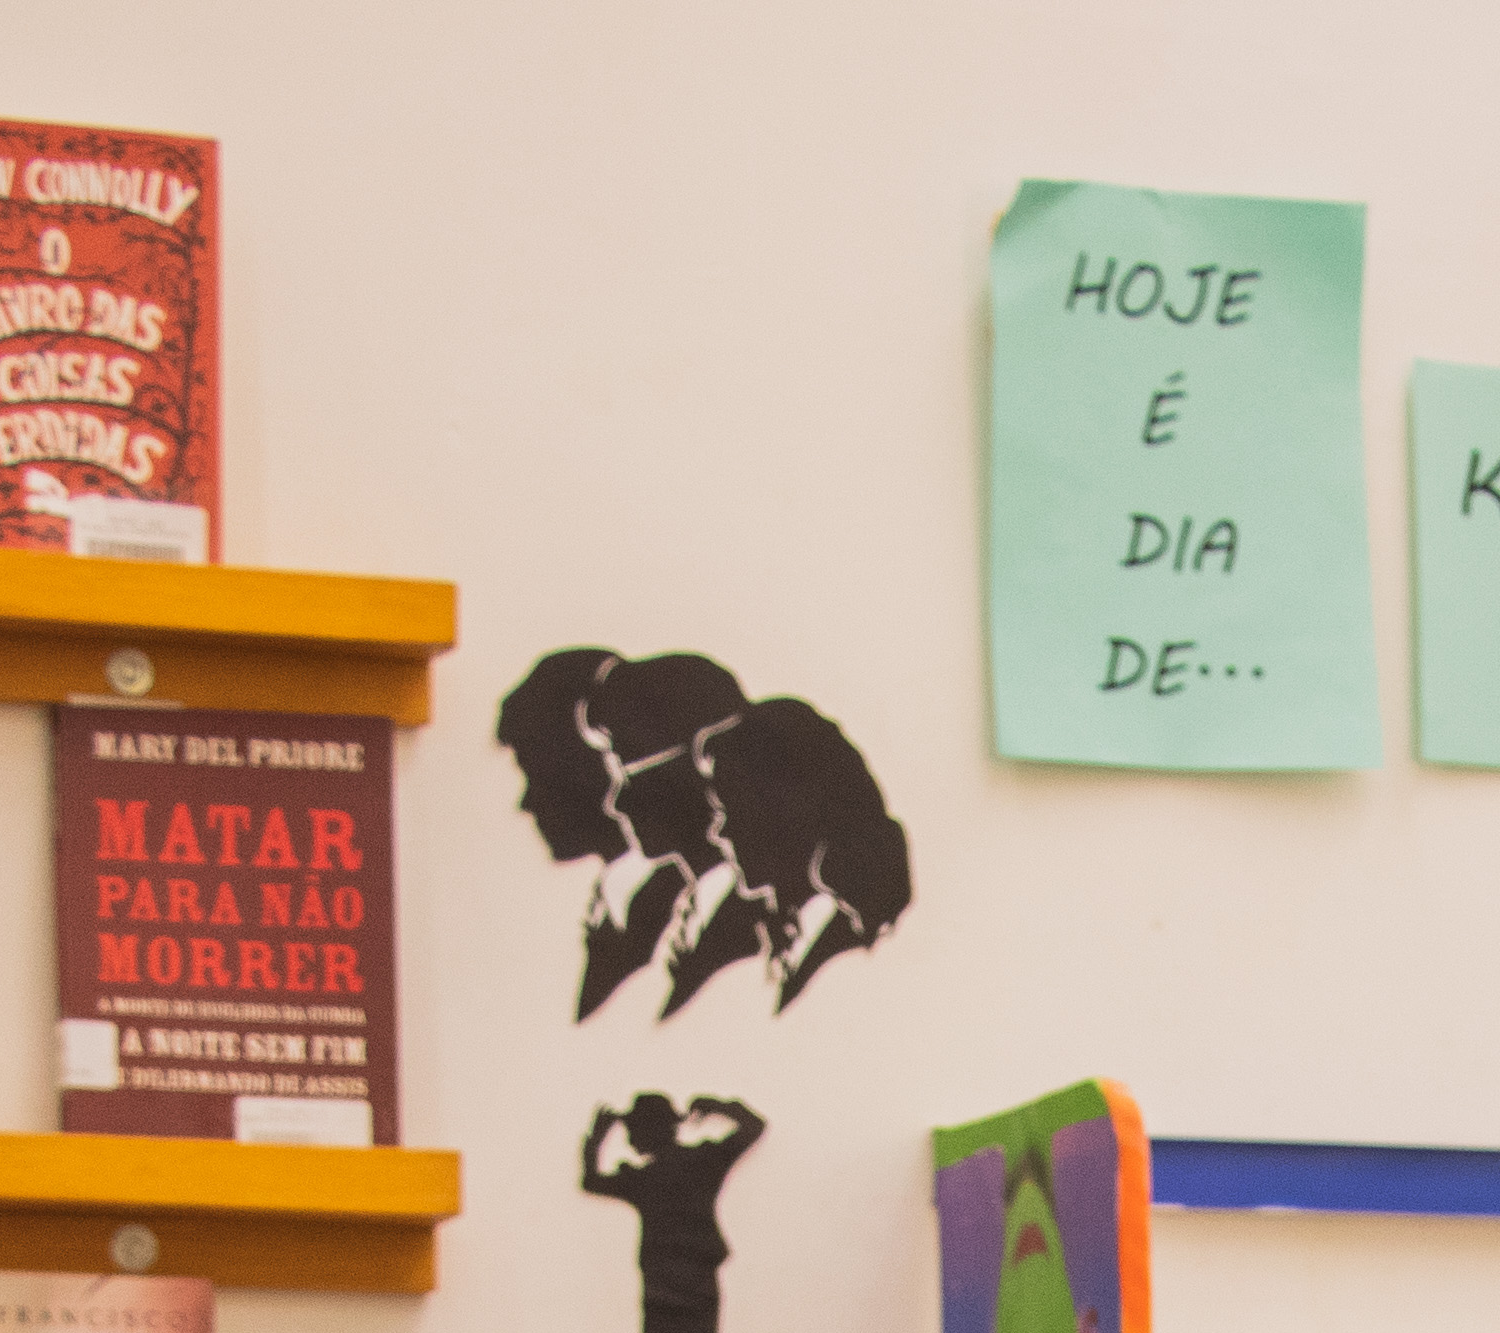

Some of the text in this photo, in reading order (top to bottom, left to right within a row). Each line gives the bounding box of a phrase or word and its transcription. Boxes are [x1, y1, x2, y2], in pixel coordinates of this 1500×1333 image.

[23, 157, 200, 226] CONNOLLY
[38, 227, 72, 277] O
[86, 288, 168, 353] DAS
[1063, 250, 1265, 327] HOJE
[1139, 370, 1189, 447] É
[1120, 510, 1241, 575] DIA
[1096, 634, 1266, 698] DE...
[92, 730, 366, 773] MARY DEL PRIORE
[93, 797, 365, 872] MATAR
[96, 871, 366, 931] PARA NÃO
[96, 932, 366, 994] MORRER
[121, 1026, 369, 1067] A NOITE SEM FIM
